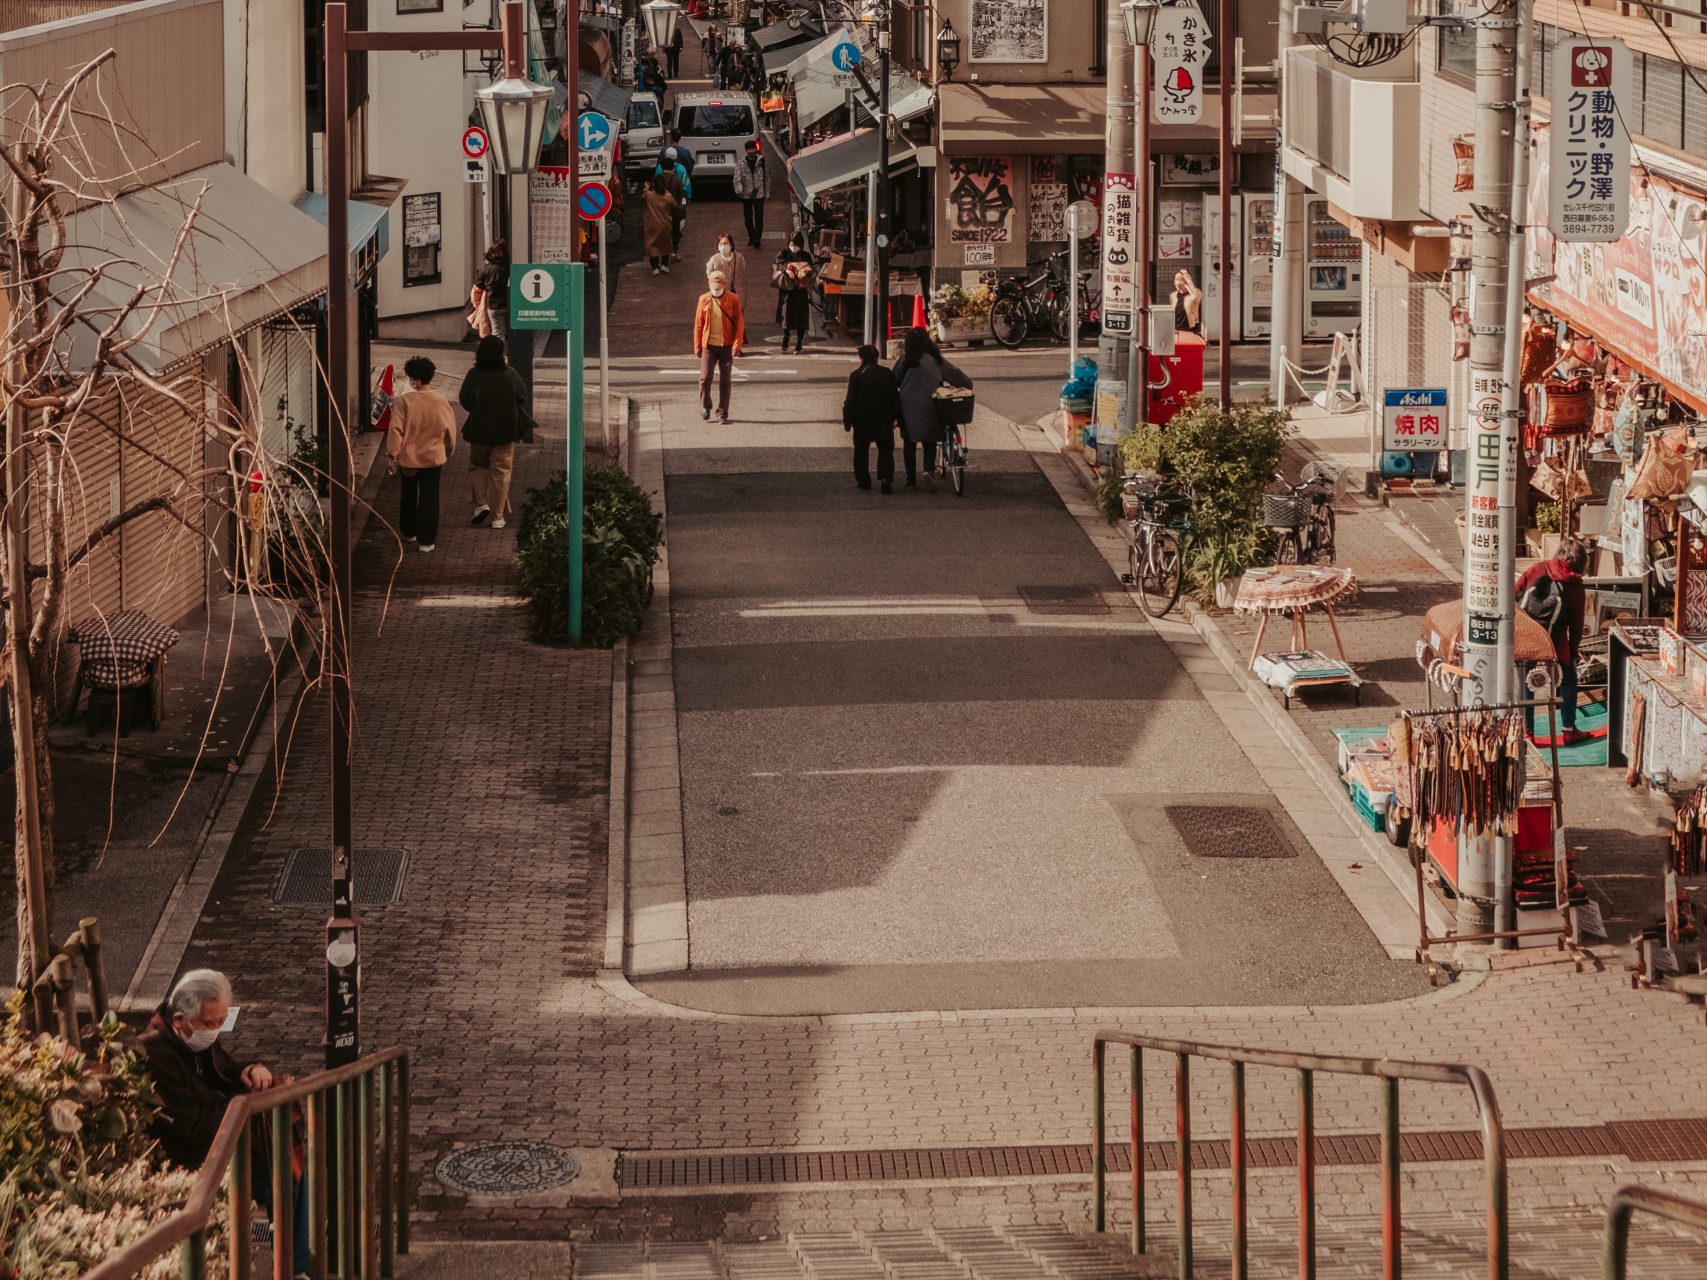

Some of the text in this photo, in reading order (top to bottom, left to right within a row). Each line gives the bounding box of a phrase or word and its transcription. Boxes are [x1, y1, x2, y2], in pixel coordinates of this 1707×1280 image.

[1182, 16, 1197, 63] かき氷
[1160, 103, 1198, 116] ひみつ堂
[1565, 90, 1588, 199] クリニック
[1590, 90, 1616, 201] 動物・野澤
[1106, 203, 1116, 237] のお店
[1116, 193, 1132, 244] 猫雑貨
[1563, 214, 1615, 223] 西日暮里6-56-3
[951, 227, 1008, 243] SINCE 1922
[1563, 224, 1615, 234] 3894-7739
[1400, 392, 1432, 406] Asahi
[1482, 403, 1500, 424] 質
[1395, 414, 1439, 436] 焼肉
[1393, 438, 1440, 448] サラリーマン
[1472, 629, 1498, 640] 3-13
